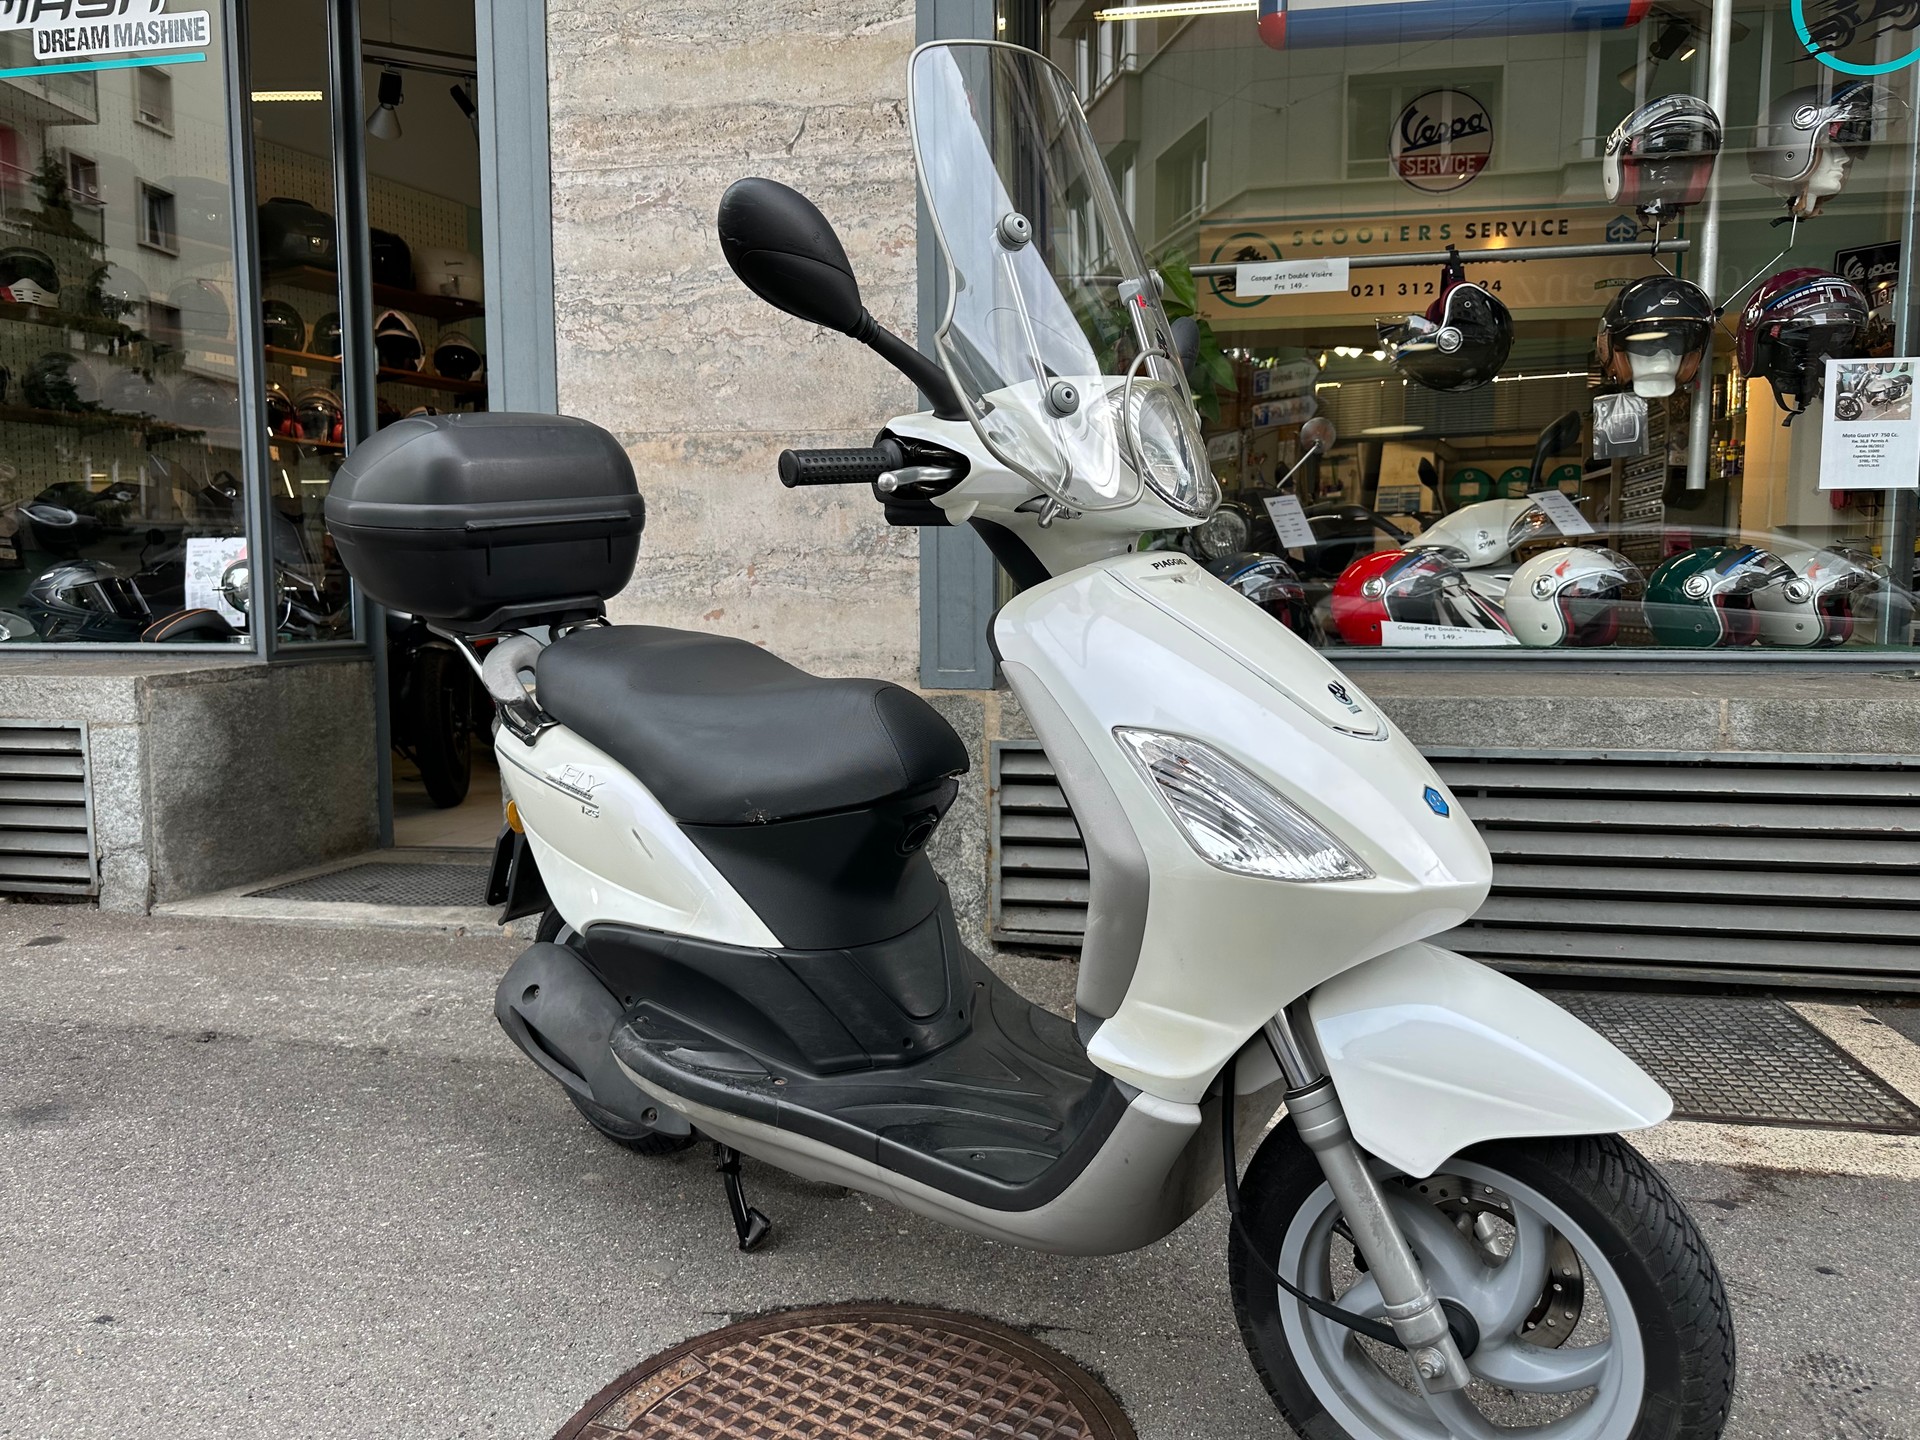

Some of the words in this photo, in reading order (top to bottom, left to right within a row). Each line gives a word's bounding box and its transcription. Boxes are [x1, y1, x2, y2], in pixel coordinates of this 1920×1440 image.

[37, 25, 110, 54] DREAM
[113, 16, 206, 48] MASHINE
[1401, 105, 1488, 153] Vespa
[1405, 154, 1477, 175] SERVICE
[1292, 223, 1451, 247] SCOOTERS
[1464, 218, 1569, 239] SERVICE
[1288, 272, 1309, 280] Double
[1351, 284, 1385, 298] 021
[1398, 282, 1434, 296] 312
[1478, 540, 1496, 550] SYM
[1151, 559, 1187, 570] PIAGGIO
[1397, 624, 1421, 632] Casque
[560, 764, 607, 794] FLY
[581, 805, 600, 819] 125
